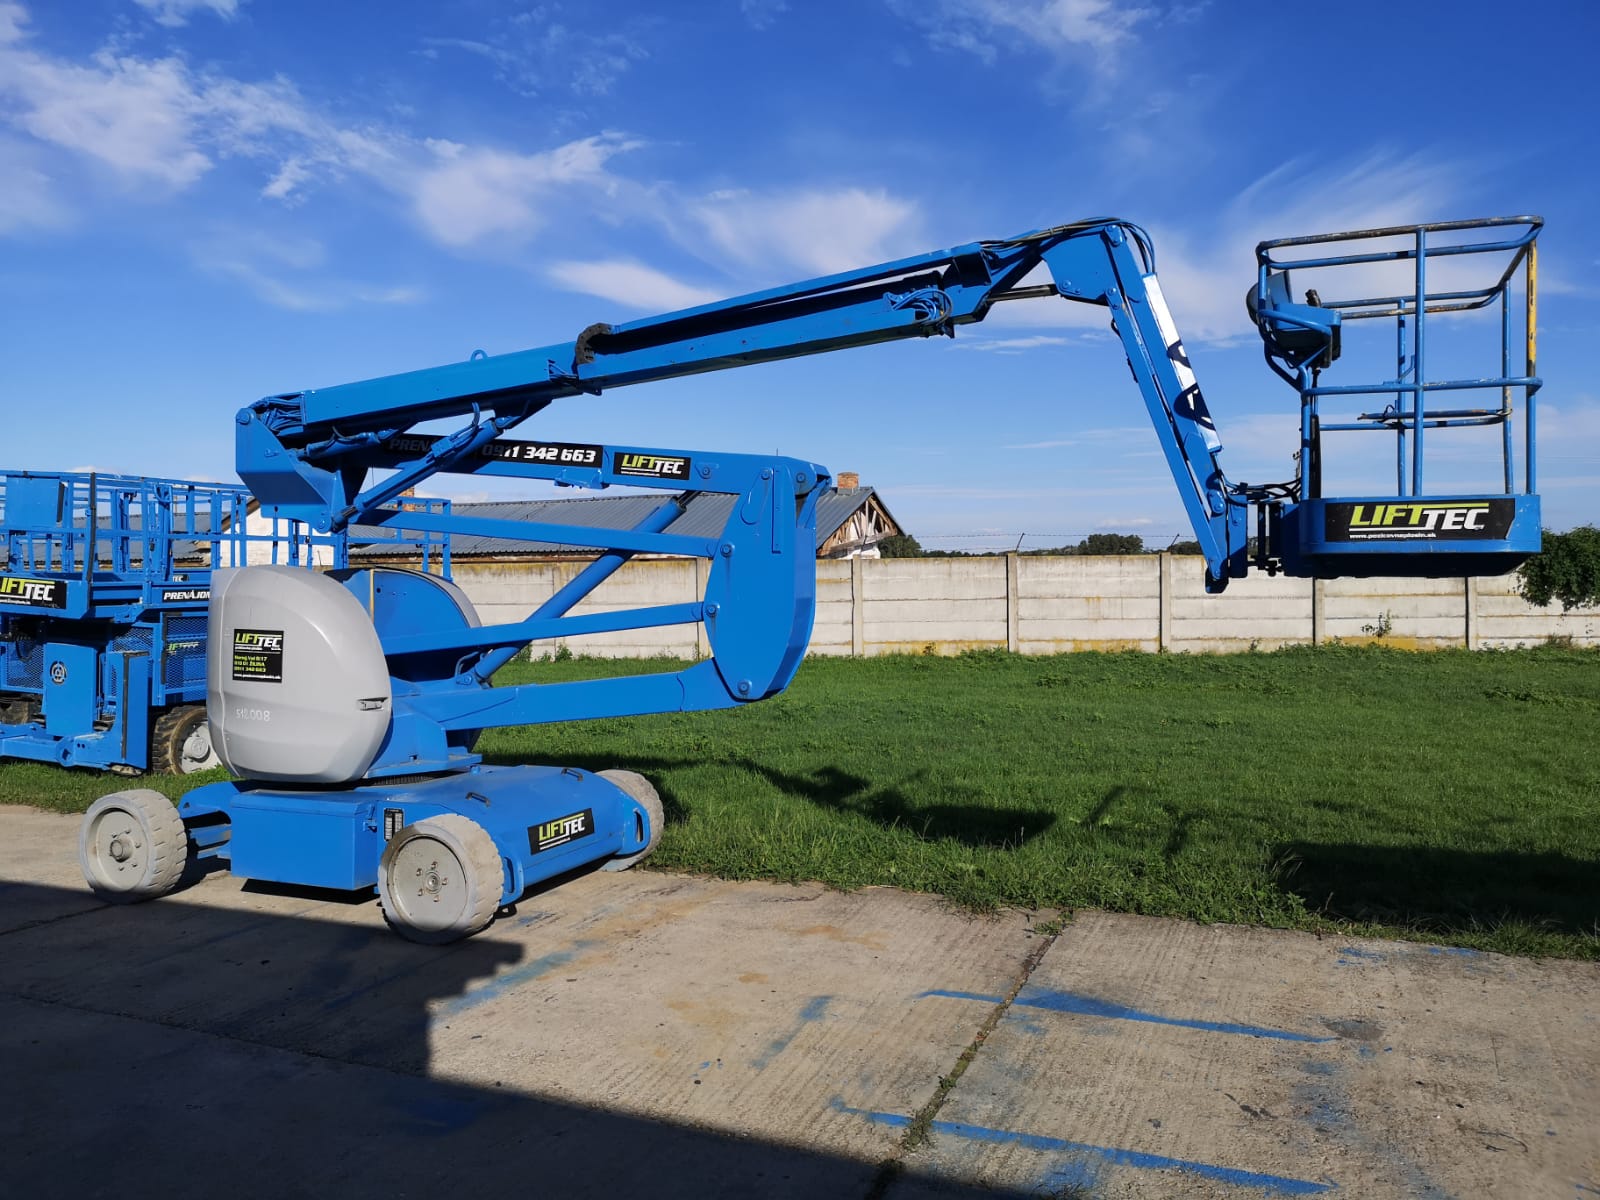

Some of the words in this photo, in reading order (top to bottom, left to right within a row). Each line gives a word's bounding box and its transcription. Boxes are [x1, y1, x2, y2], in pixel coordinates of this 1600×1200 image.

[524, 446, 559, 460] 342
[561, 448, 597, 462] 663
[0, 576, 56, 602] IFTTEC
